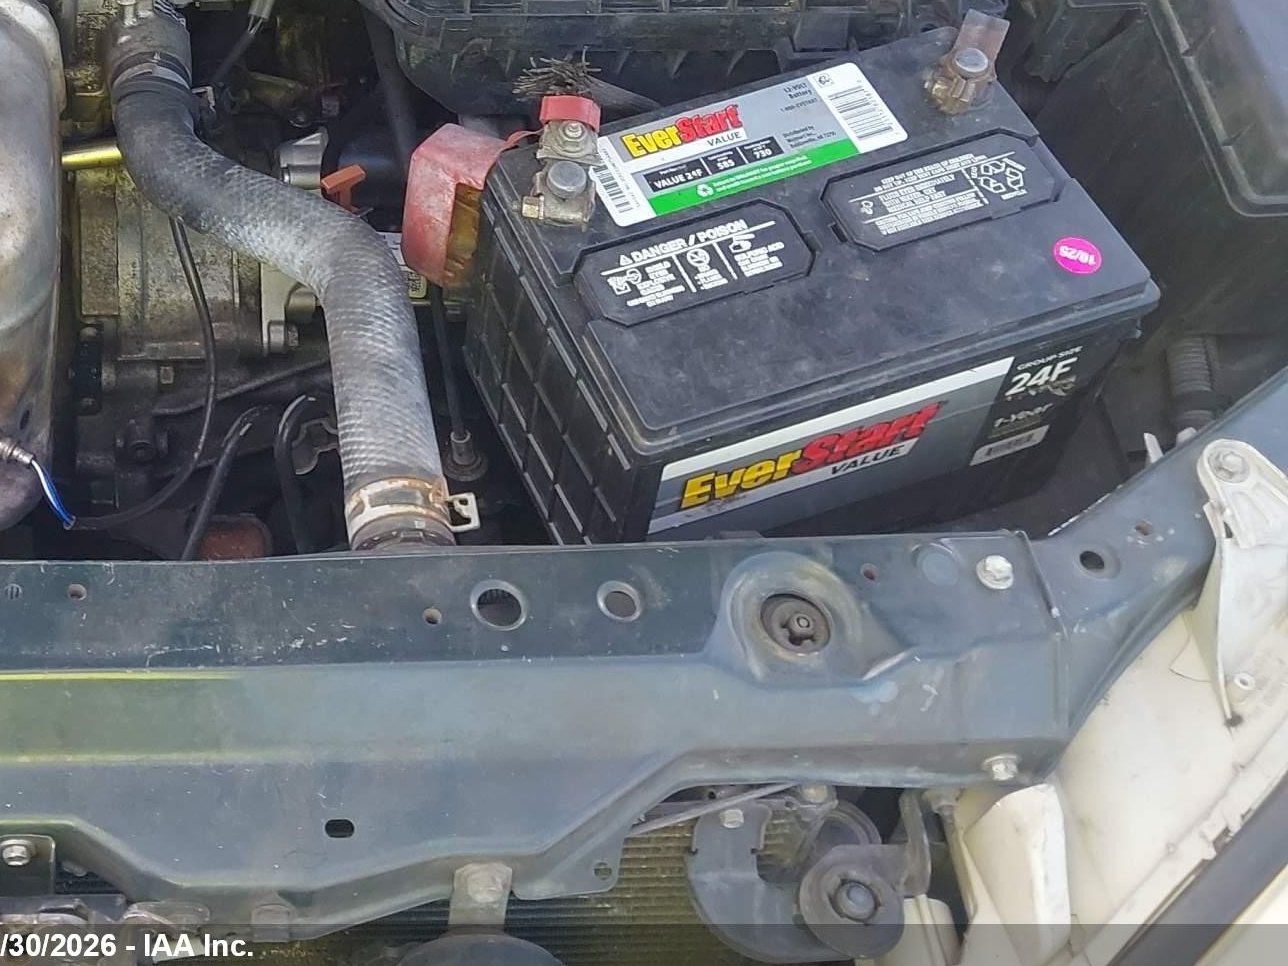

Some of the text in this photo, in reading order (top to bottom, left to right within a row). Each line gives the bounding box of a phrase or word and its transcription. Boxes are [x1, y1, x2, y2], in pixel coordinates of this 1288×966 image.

[621, 104, 743, 158] EverStart
[706, 131, 742, 146] VALUE
[755, 148, 772, 160] 730
[653, 173, 686, 189] VALUE
[685, 168, 703, 180] 24F
[631, 238, 689, 262] DANGER
[698, 219, 747, 242] POISON
[1059, 245, 1096, 266] 10/25
[1005, 357, 1078, 396] 24F
[680, 401, 941, 510] EverStart
[831, 444, 905, 475] VALUE
